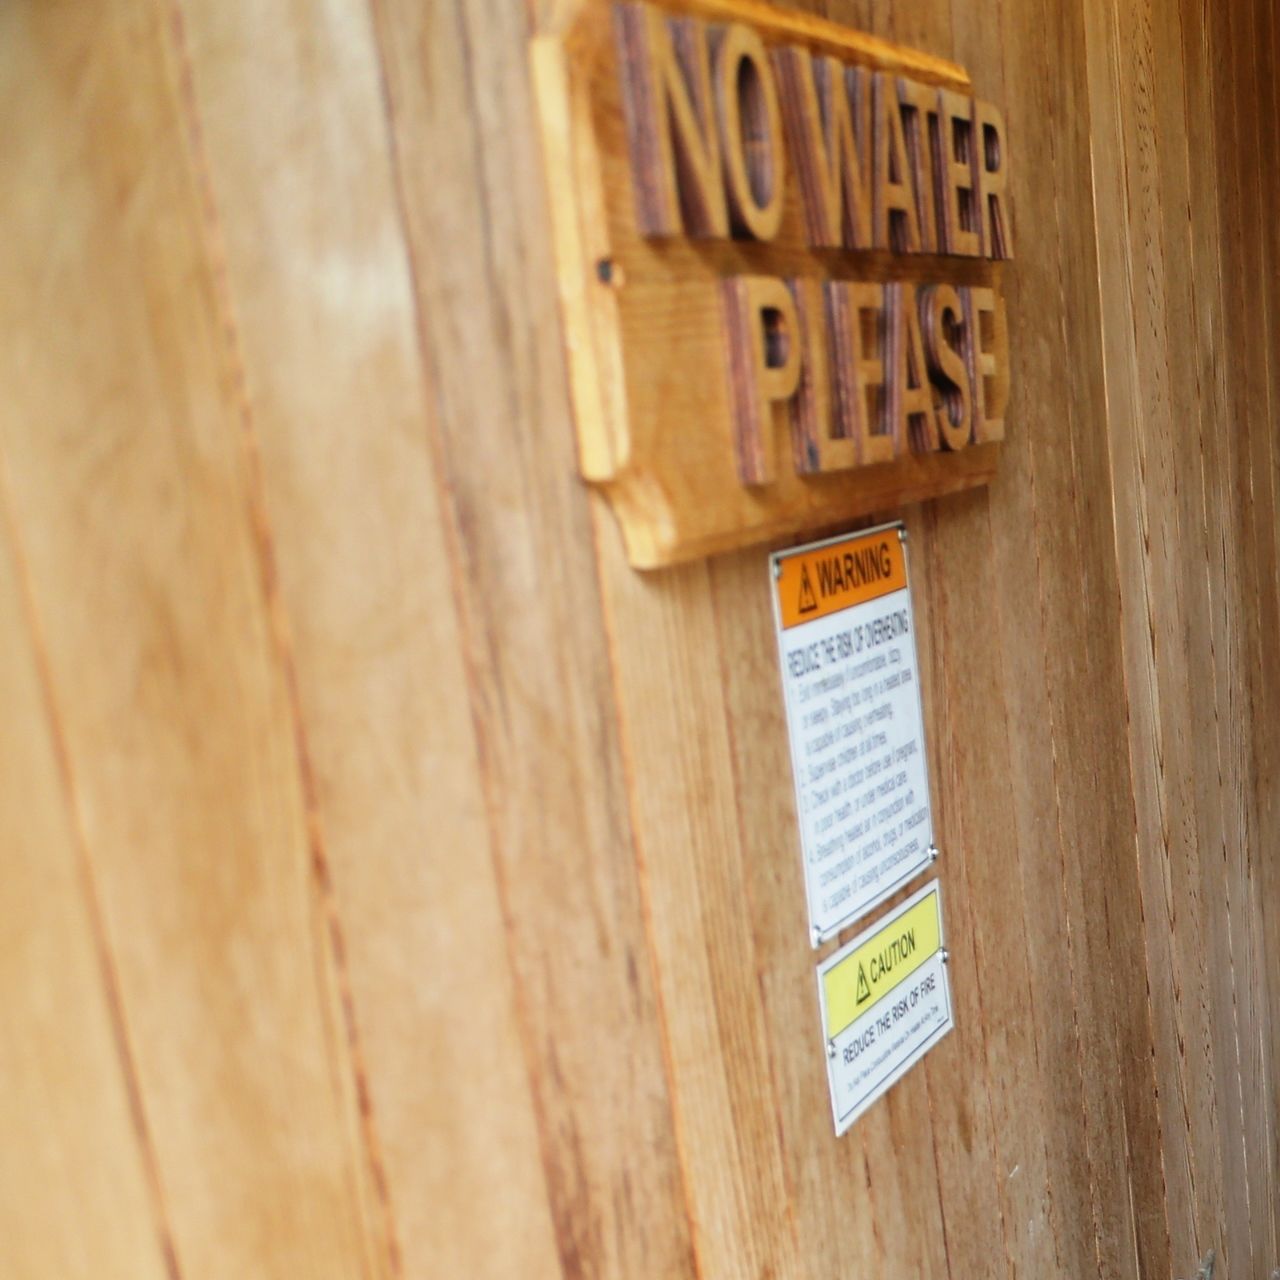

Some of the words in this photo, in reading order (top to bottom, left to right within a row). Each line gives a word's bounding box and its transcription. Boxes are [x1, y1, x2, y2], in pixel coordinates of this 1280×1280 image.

[614, 0, 784, 240] NO
[773, 44, 1014, 260] WATER
[719, 274, 1005, 485] PLEASE
[816, 542, 891, 598] WARNING
[869, 928, 916, 983] CAUTION
[842, 1026, 875, 1065] REDUCE
[876, 1011, 891, 1037] THE
[892, 994, 909, 1023] RISK
[909, 987, 919, 1008] OF
[920, 972, 936, 998] FIRE
